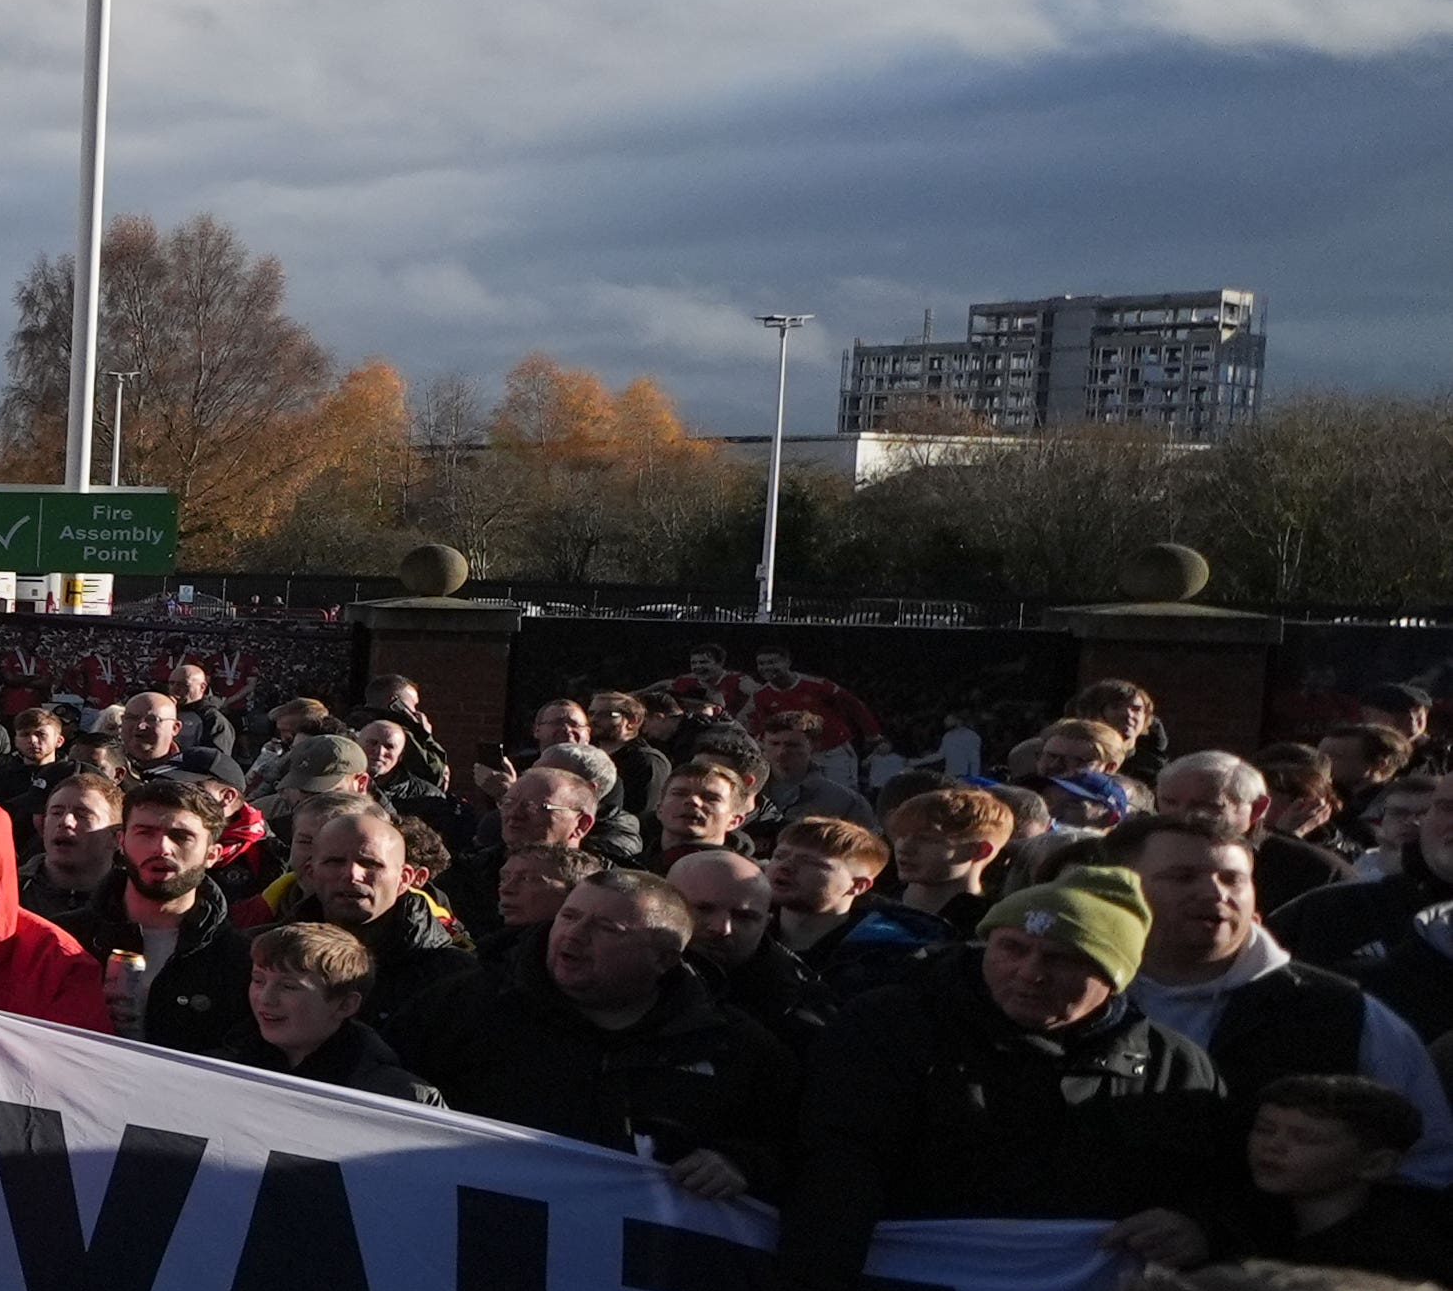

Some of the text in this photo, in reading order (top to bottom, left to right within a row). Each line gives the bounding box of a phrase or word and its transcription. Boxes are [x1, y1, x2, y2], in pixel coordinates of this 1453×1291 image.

[92, 505, 133, 521] Fire
[59, 525, 164, 545] Assembly
[83, 546, 139, 562] Point
